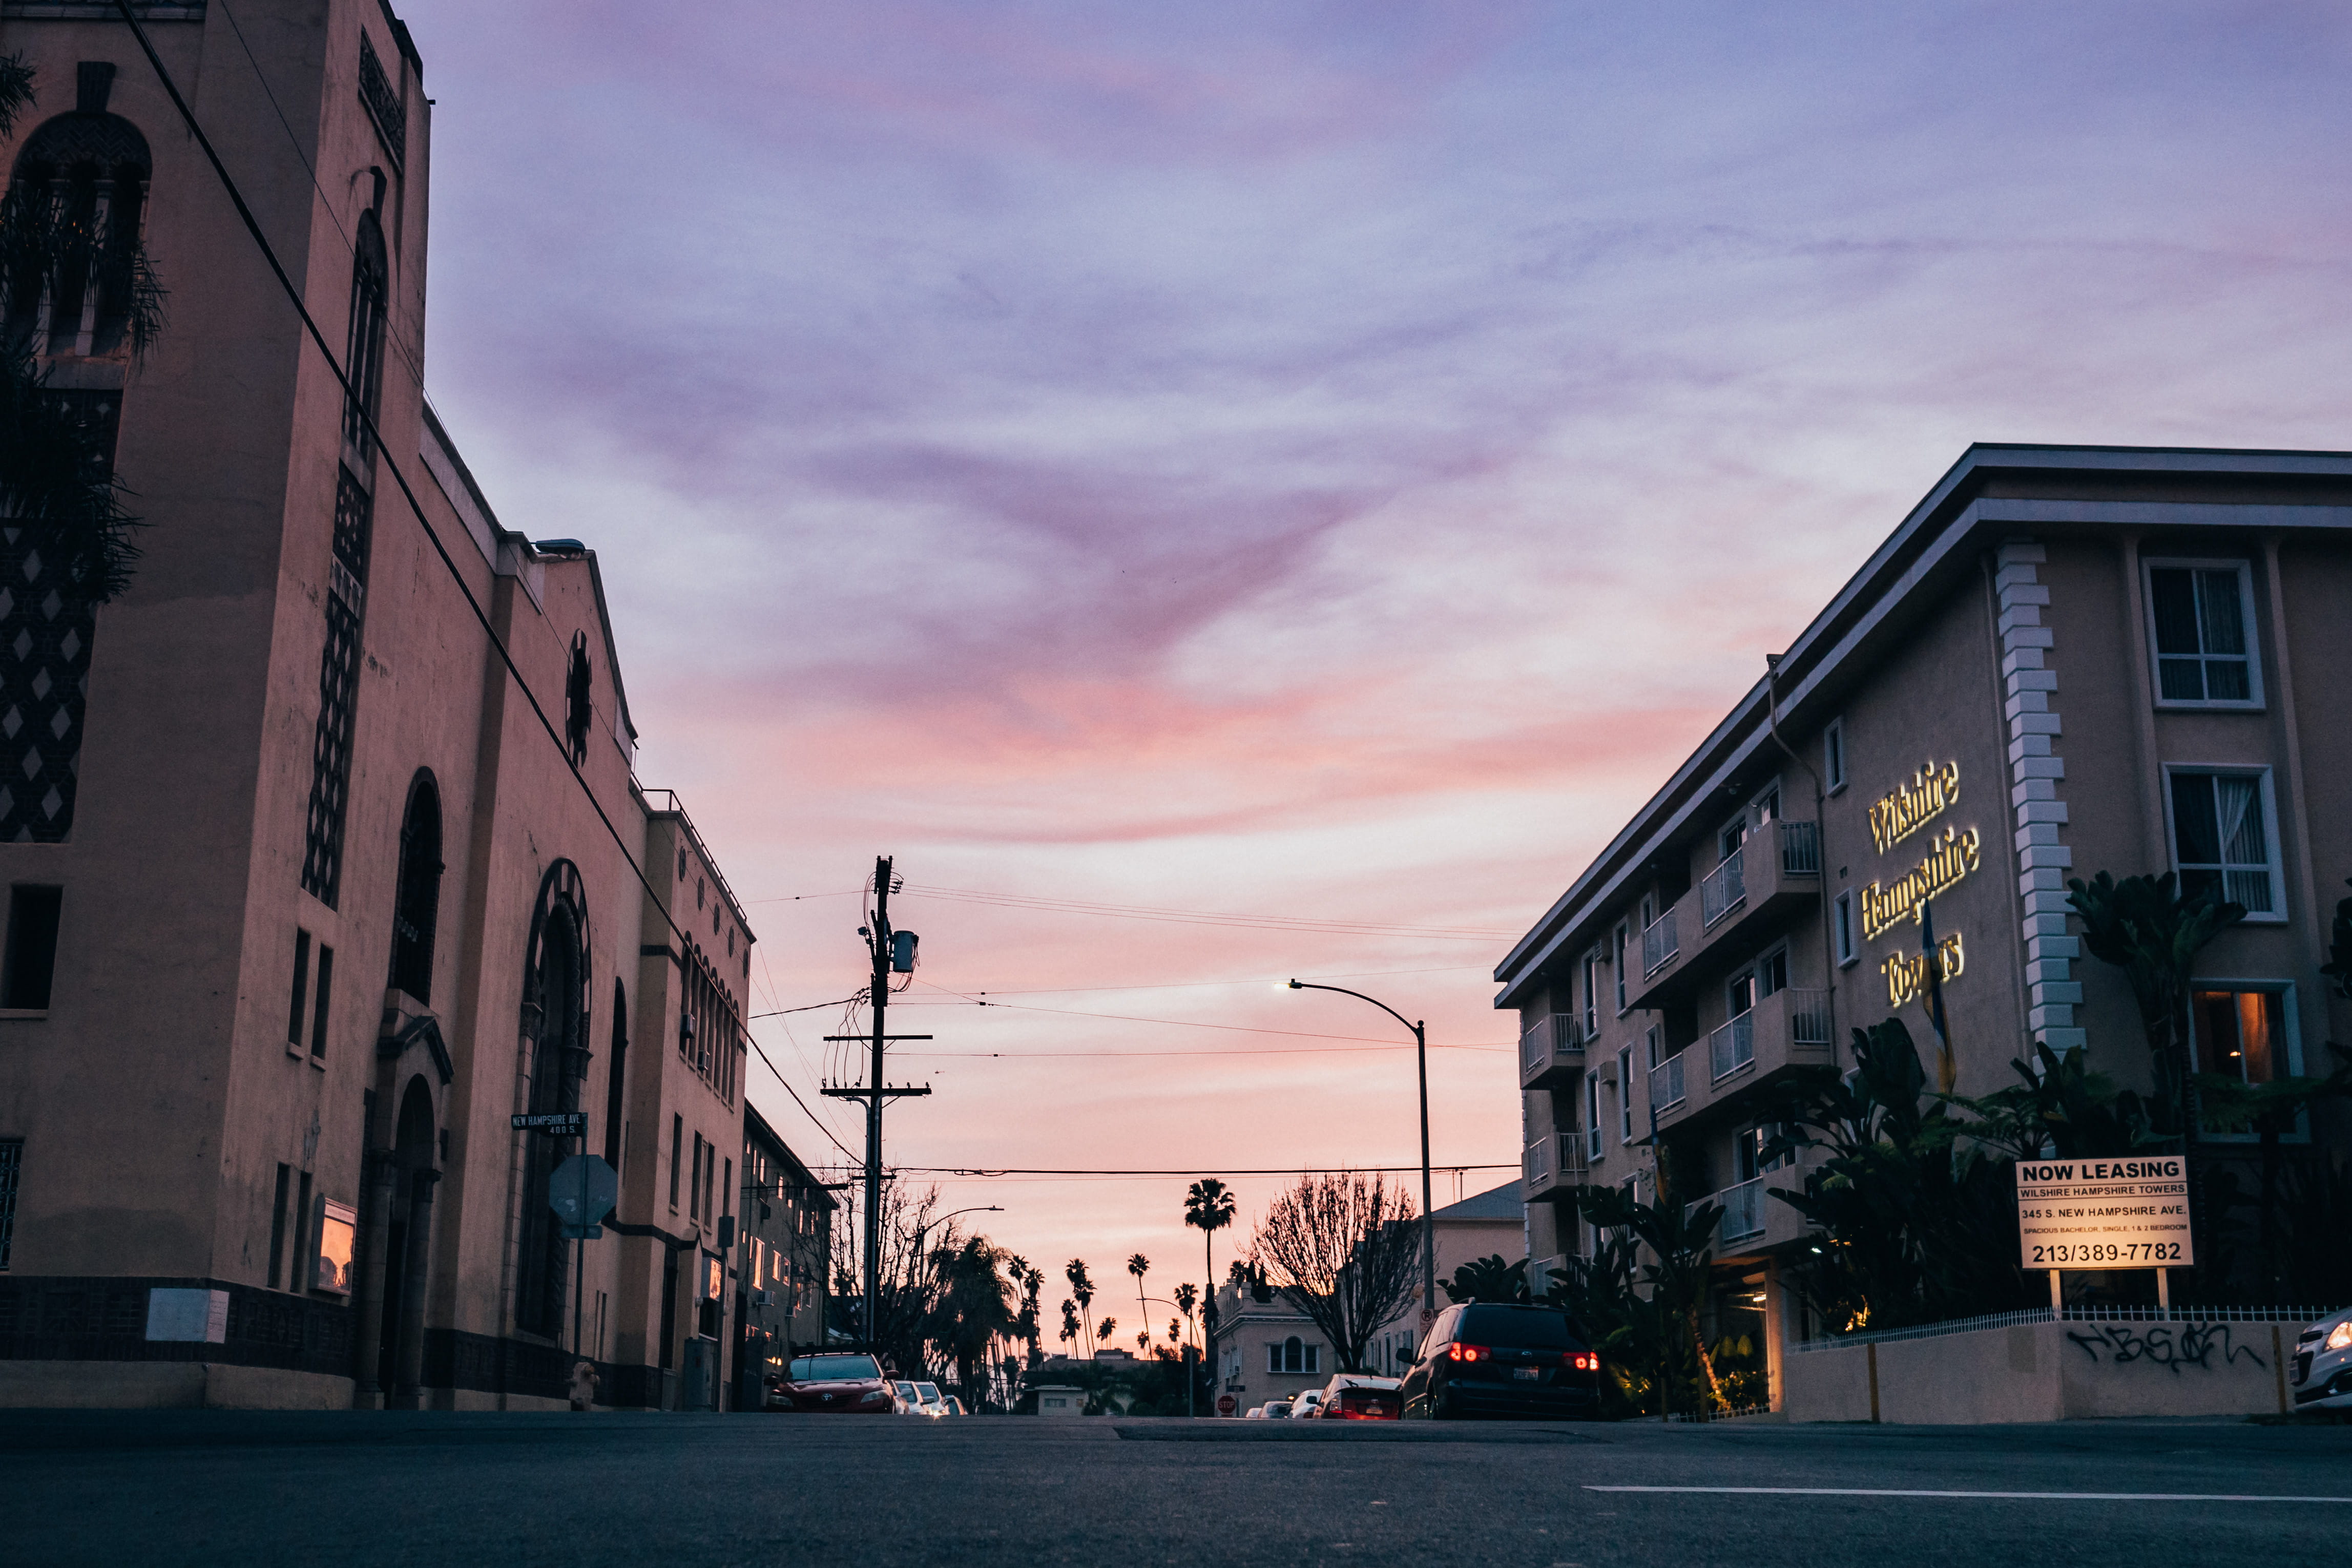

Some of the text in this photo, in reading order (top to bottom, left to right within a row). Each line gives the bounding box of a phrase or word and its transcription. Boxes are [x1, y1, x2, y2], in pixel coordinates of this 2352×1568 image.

[1867, 761, 1959, 855] Wilshire
[1861, 827, 1979, 940] Hampshire
[513, 1116, 527, 1126] NEW
[528, 1115, 566, 1126] HAMPSHIRE
[2023, 1161, 2179, 1181] NOW LEASING
[2021, 1184, 2185, 1198] WILSHIRE HAMPSHIRE TOWERS
[2022, 1205, 2187, 1219] 345 S. NEW HAMPSHIRE AVE.
[2032, 1242, 2181, 1263] 213/389-7782
